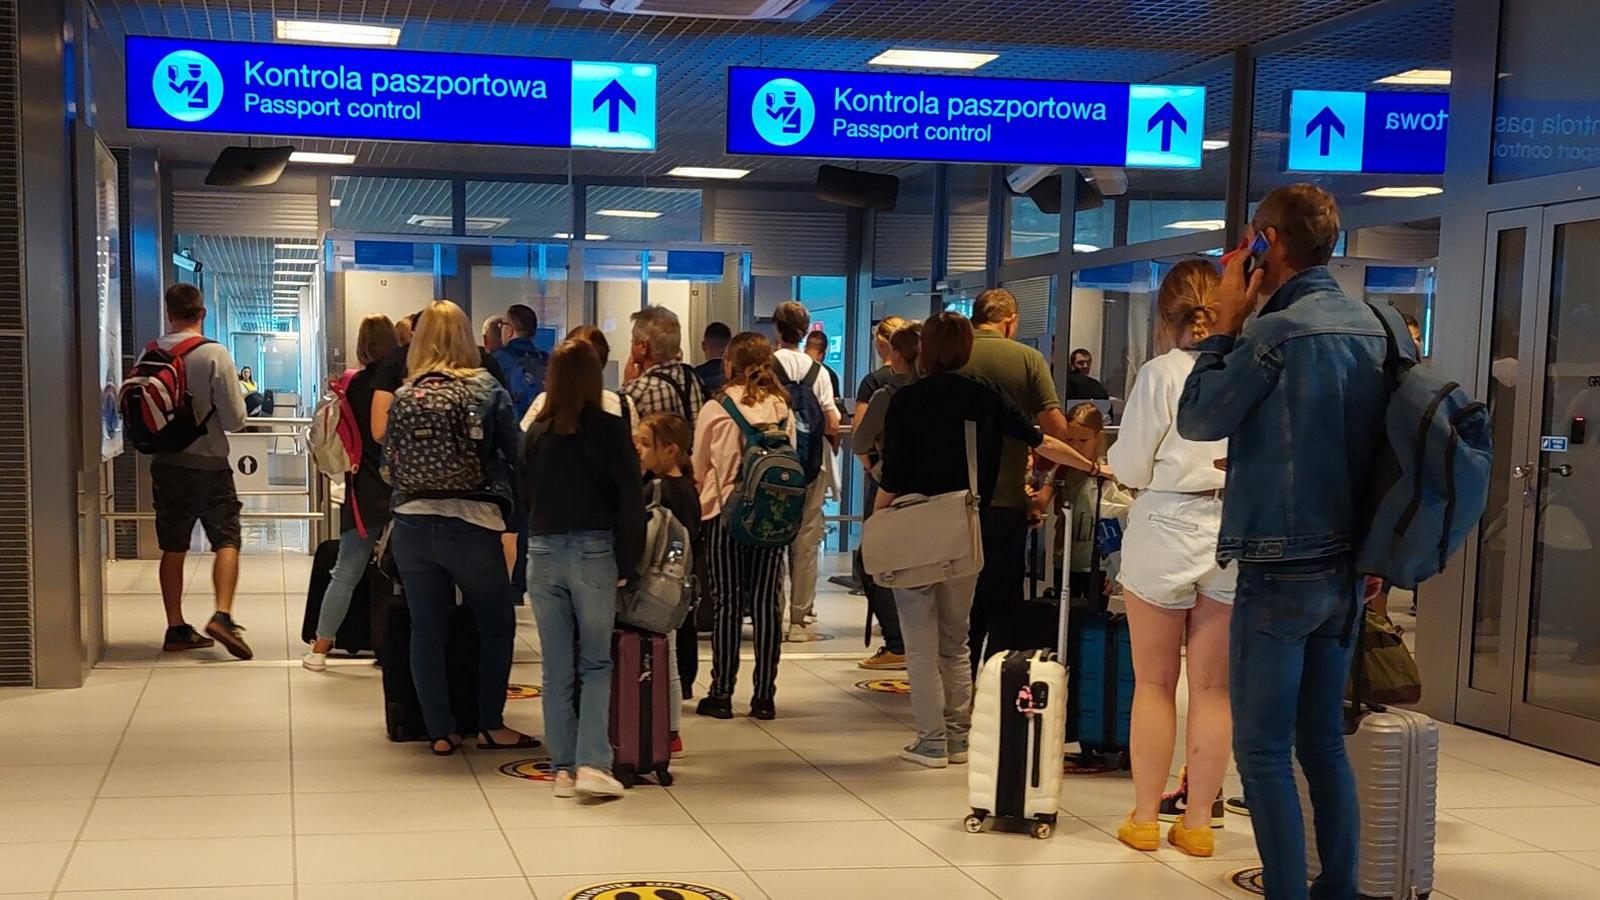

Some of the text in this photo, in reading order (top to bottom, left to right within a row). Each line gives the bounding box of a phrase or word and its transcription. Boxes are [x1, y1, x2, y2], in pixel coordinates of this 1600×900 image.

[244, 60, 548, 100] Kontrola paszportowa
[244, 92, 421, 120] Passport control
[834, 87, 1107, 122] Kontrola paszportowa
[833, 118, 992, 142] Passport control
